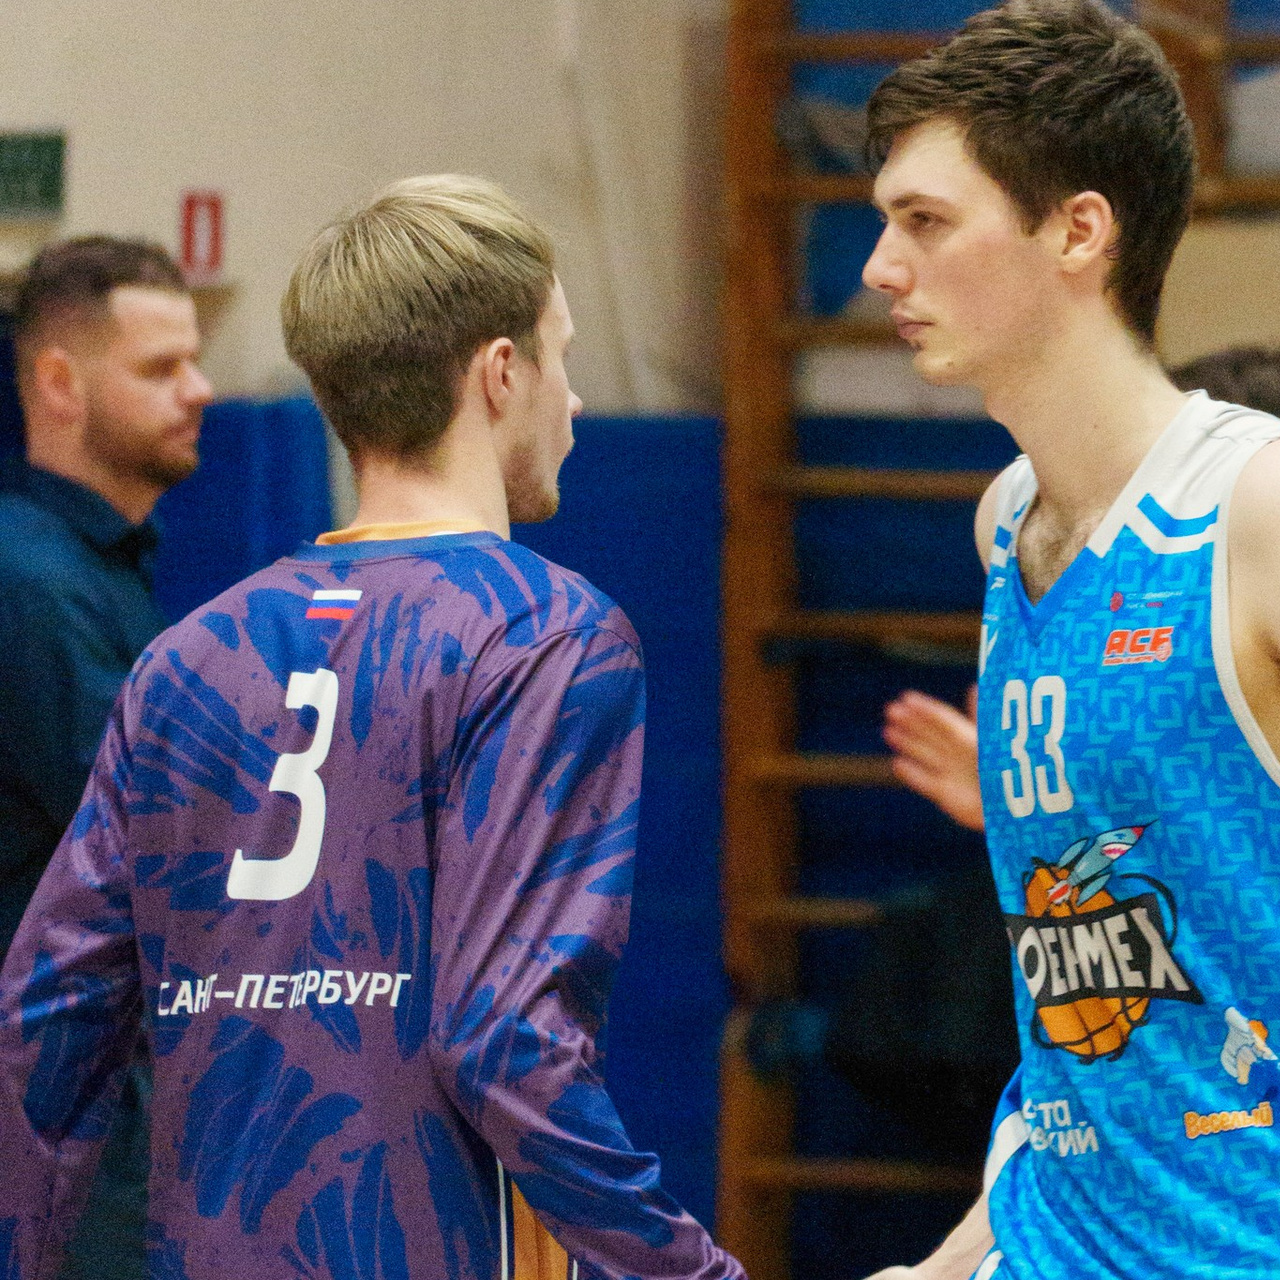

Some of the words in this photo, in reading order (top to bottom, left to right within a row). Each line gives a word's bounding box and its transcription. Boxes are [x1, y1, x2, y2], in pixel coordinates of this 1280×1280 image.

[226, 667, 339, 901] 3
[1001, 675, 1074, 819] 33
[1006, 907, 1190, 1000] ОЕНМЕХ
